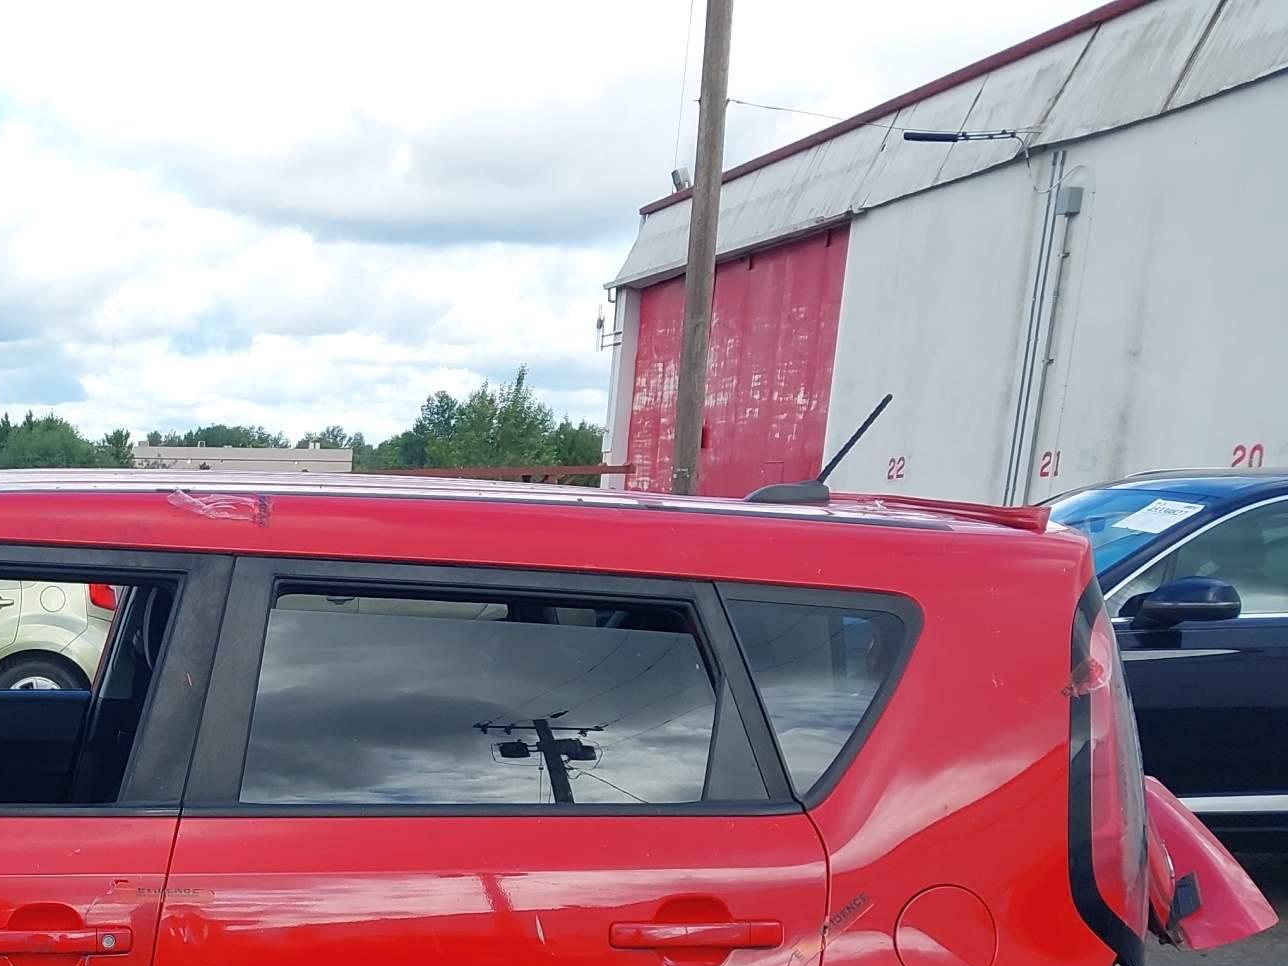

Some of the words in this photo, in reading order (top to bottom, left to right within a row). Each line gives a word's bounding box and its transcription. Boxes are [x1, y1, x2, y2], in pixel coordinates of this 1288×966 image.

[887, 456, 906, 480] 22
[1039, 450, 1061, 478] 21
[1231, 443, 1264, 468] 20
